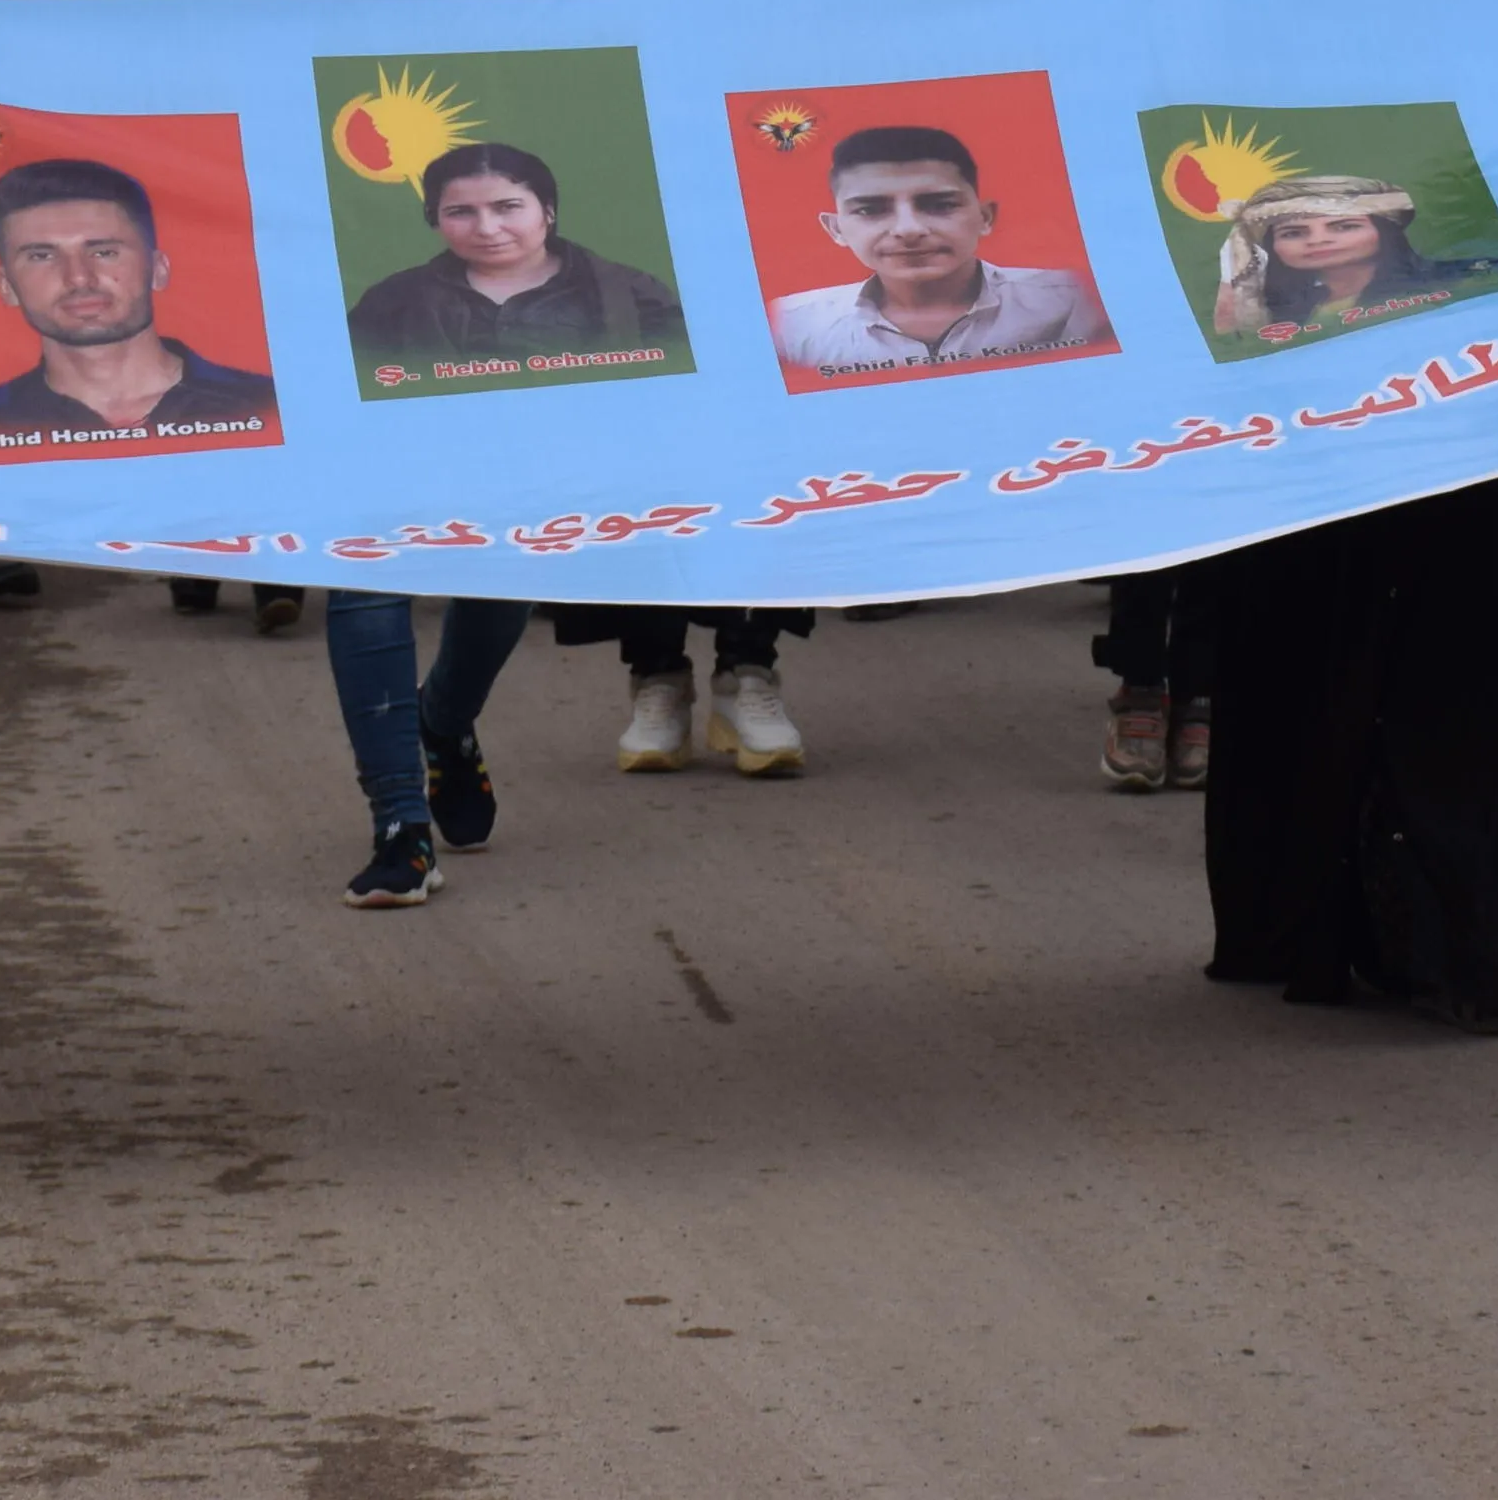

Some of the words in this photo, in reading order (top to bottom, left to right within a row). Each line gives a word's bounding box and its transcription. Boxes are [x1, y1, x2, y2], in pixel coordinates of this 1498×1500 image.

[1338, 290, 1452, 325] Zehra
[433, 358, 521, 379] Hebûn
[527, 348, 665, 373] Qehraman
[904, 350, 974, 367] Faris
[51, 426, 149, 444] Hemza
[156, 416, 263, 437] Kobanê
[995, 414, 1279, 493] بفرض
[739, 472, 964, 526] حظر
[513, 505, 716, 553] جوي
